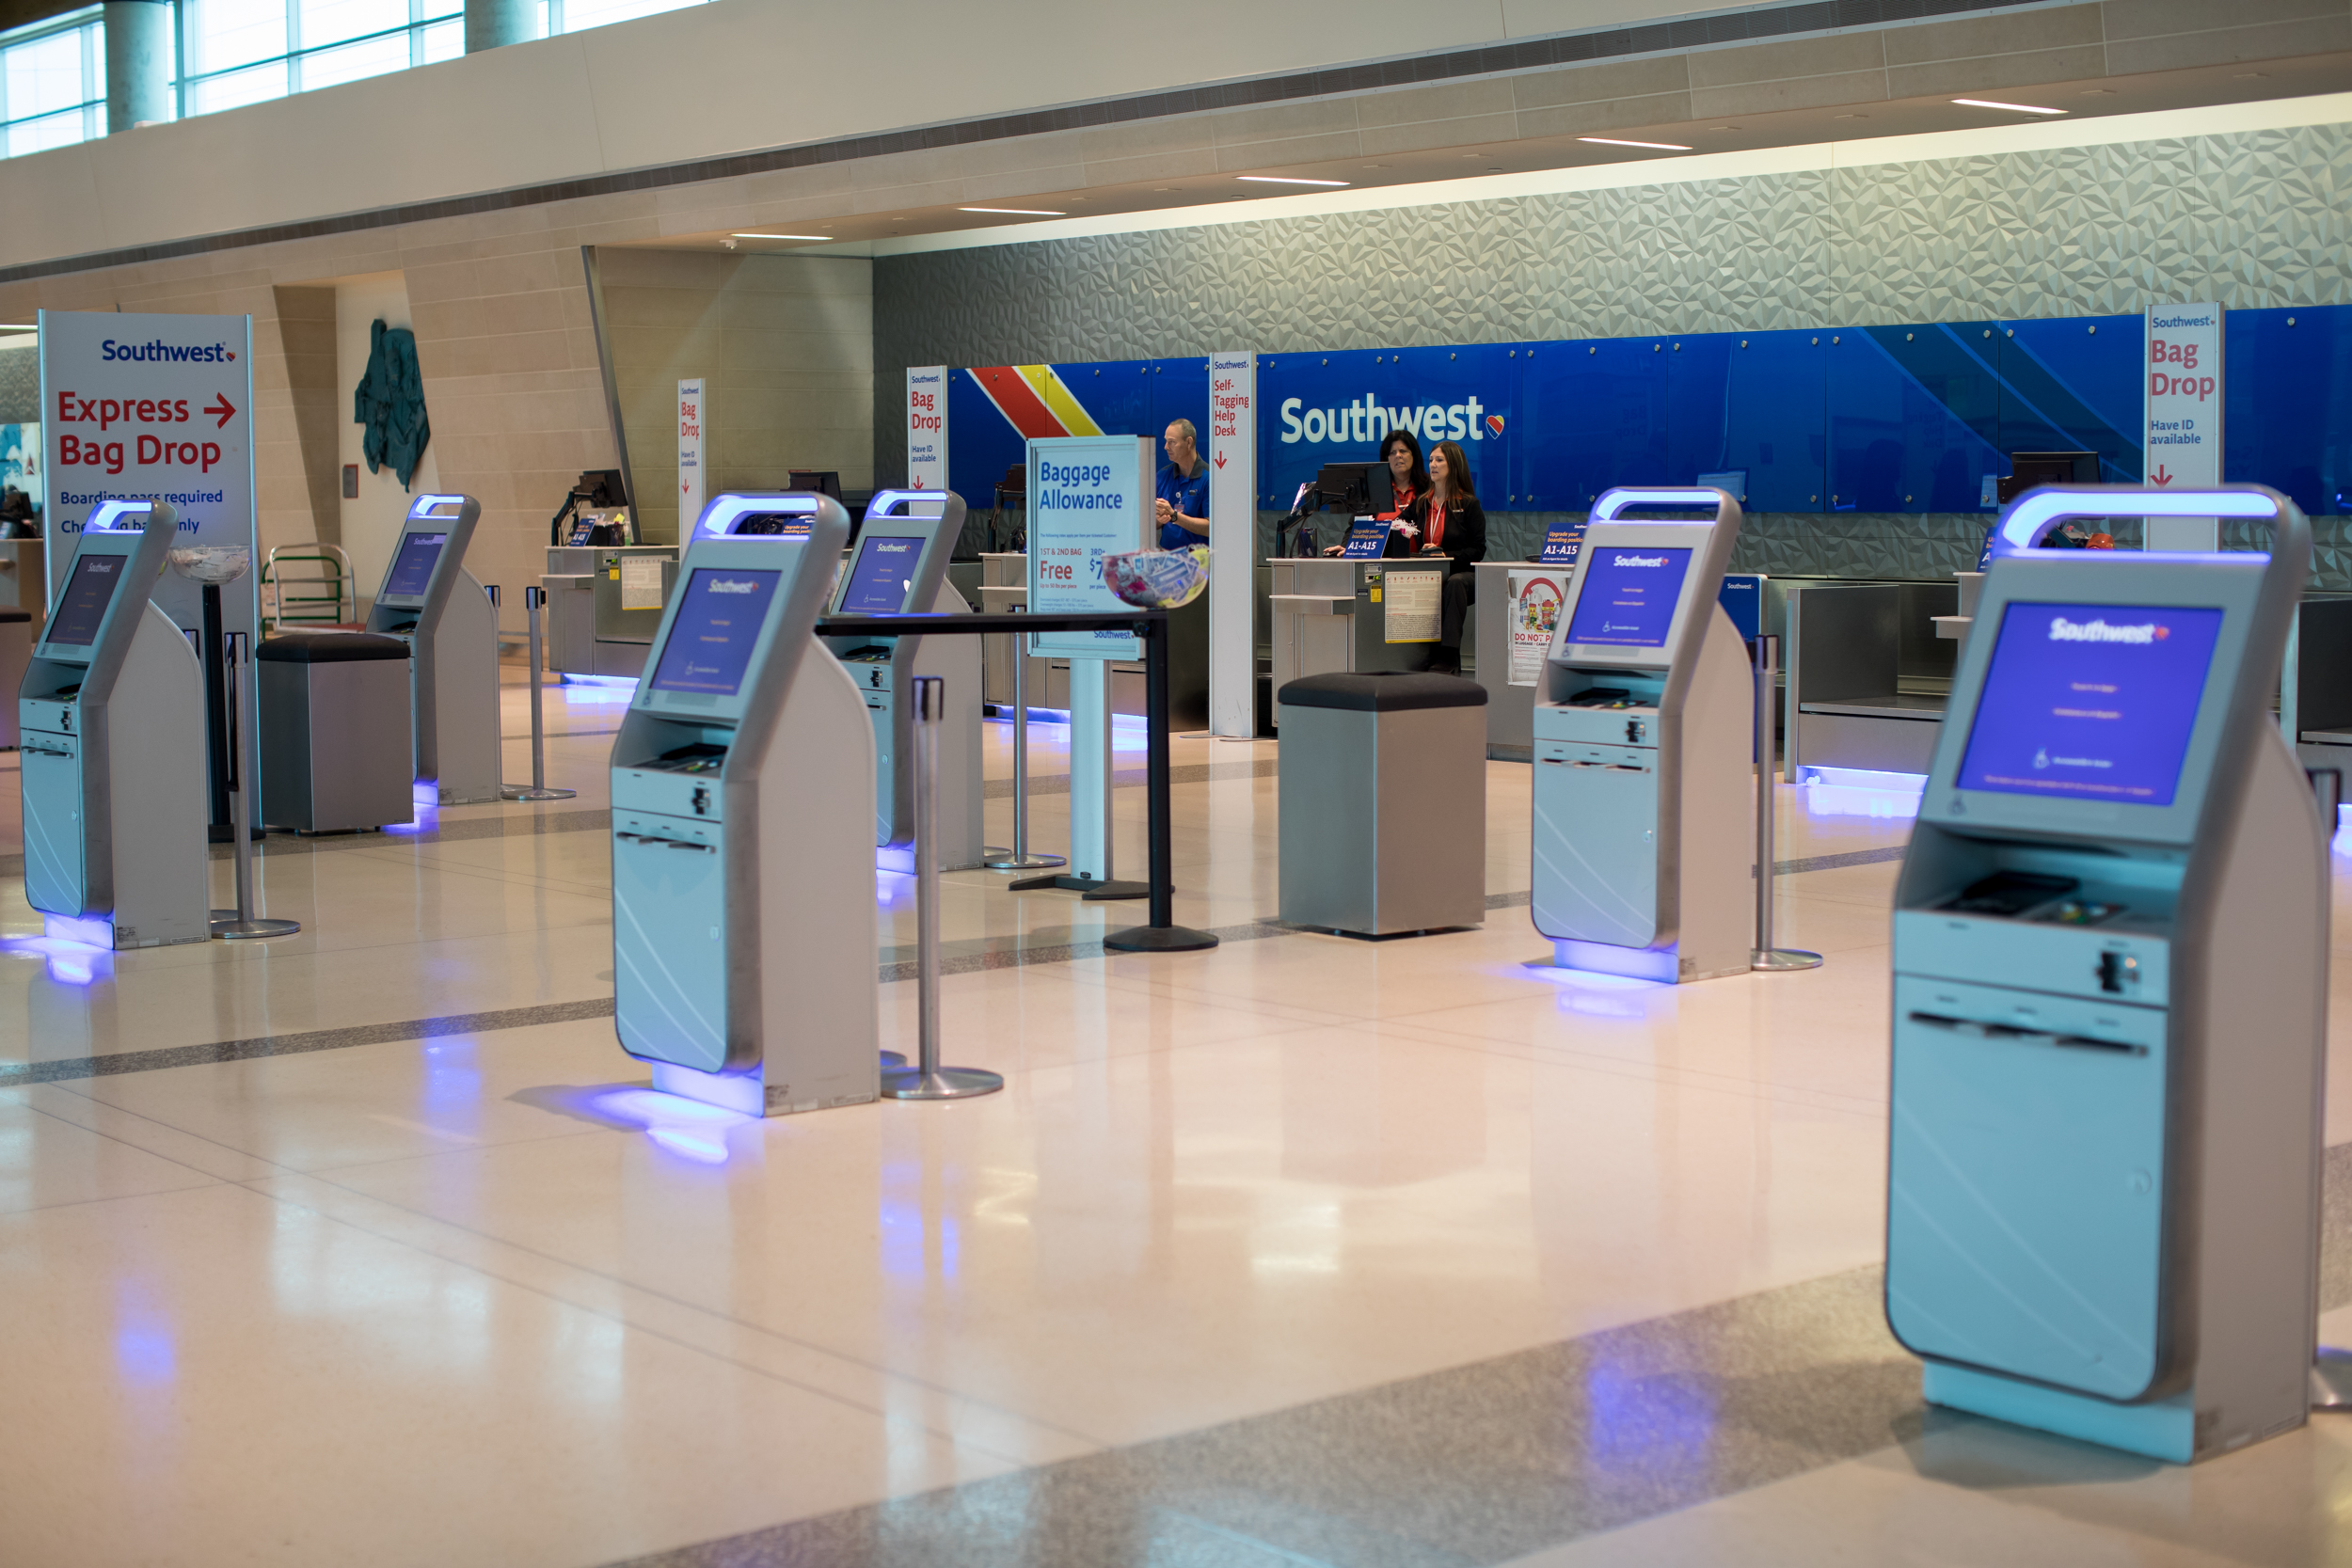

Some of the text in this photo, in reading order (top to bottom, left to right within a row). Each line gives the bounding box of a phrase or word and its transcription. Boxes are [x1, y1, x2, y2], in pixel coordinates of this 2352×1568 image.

[2153, 315, 2210, 328] Southwest
[102, 340, 225, 362] Southwest
[2152, 340, 2199, 370] Bag
[1215, 360, 1248, 370] Southwest
[912, 374, 939, 384] Southwest
[1215, 379, 1234, 391] Self-
[2152, 372, 2216, 402] Drop
[912, 391, 934, 411] Bag
[1214, 394, 1249, 409] Tagging
[58, 391, 190, 431] Express
[681, 402, 696, 420] Bag
[1215, 409, 1235, 424] Help
[1280, 393, 1484, 443] Southwest
[681, 421, 699, 440] Drop
[912, 413, 941, 434] Drop
[1215, 424, 1236, 436] Desk
[2151, 420, 2194, 431] Have ID
[2151, 433, 2201, 445] available
[59, 435, 221, 474] Bag Drop
[1041, 462, 1110, 487] Baggage
[165, 489, 223, 506] required
[1040, 489, 1122, 509] Allowance
[179, 518, 199, 534] nly
[877, 543, 907, 552] Southwest
[1347, 542, 1377, 550] A1-A15
[1544, 546, 1578, 555] A1-A15
[1090, 558, 1104, 580] $7
[1613, 555, 1662, 567] Southwest
[1041, 561, 1073, 579] Free
[1093, 630, 1131, 639] Southwest
[2048, 617, 2155, 644] Southwest
